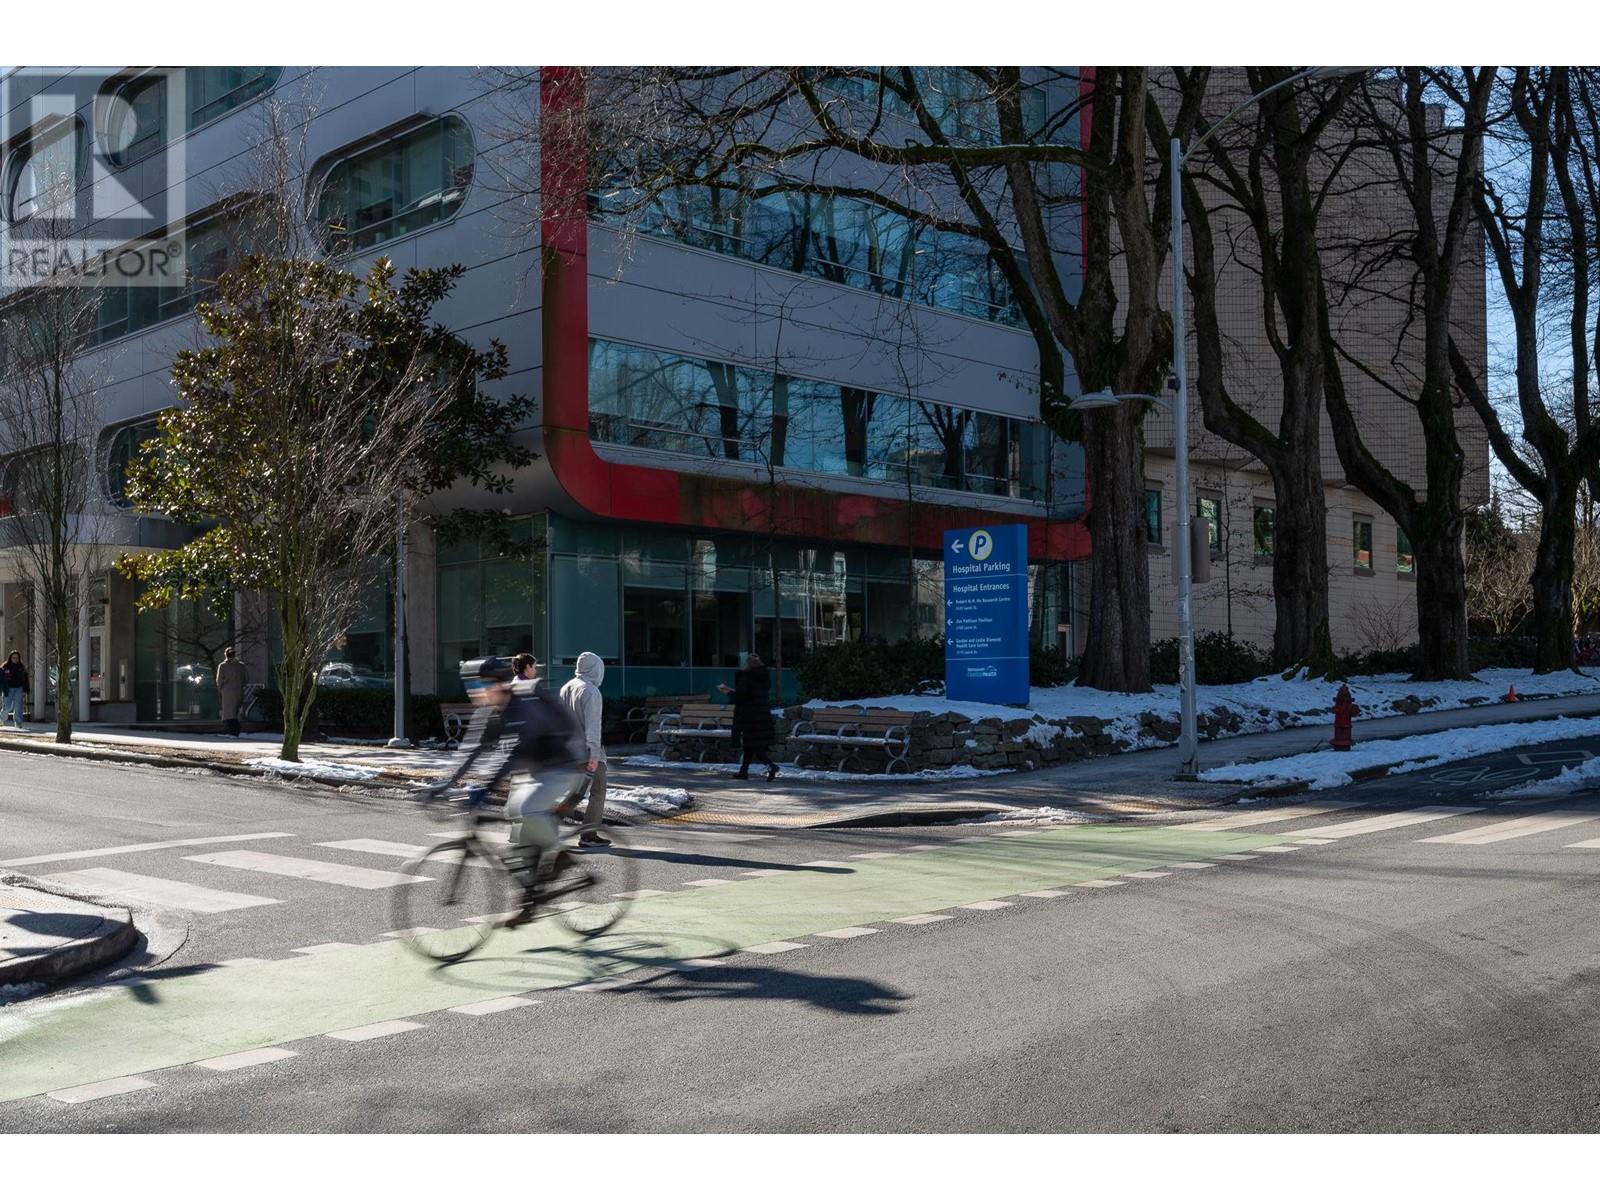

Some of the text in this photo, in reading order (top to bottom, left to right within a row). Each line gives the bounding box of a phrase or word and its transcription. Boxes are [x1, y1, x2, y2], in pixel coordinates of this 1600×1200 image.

[974, 535, 987, 555] P
[952, 562, 1011, 574] Hospital Parking
[952, 583, 1010, 594] Hospital Entrances
